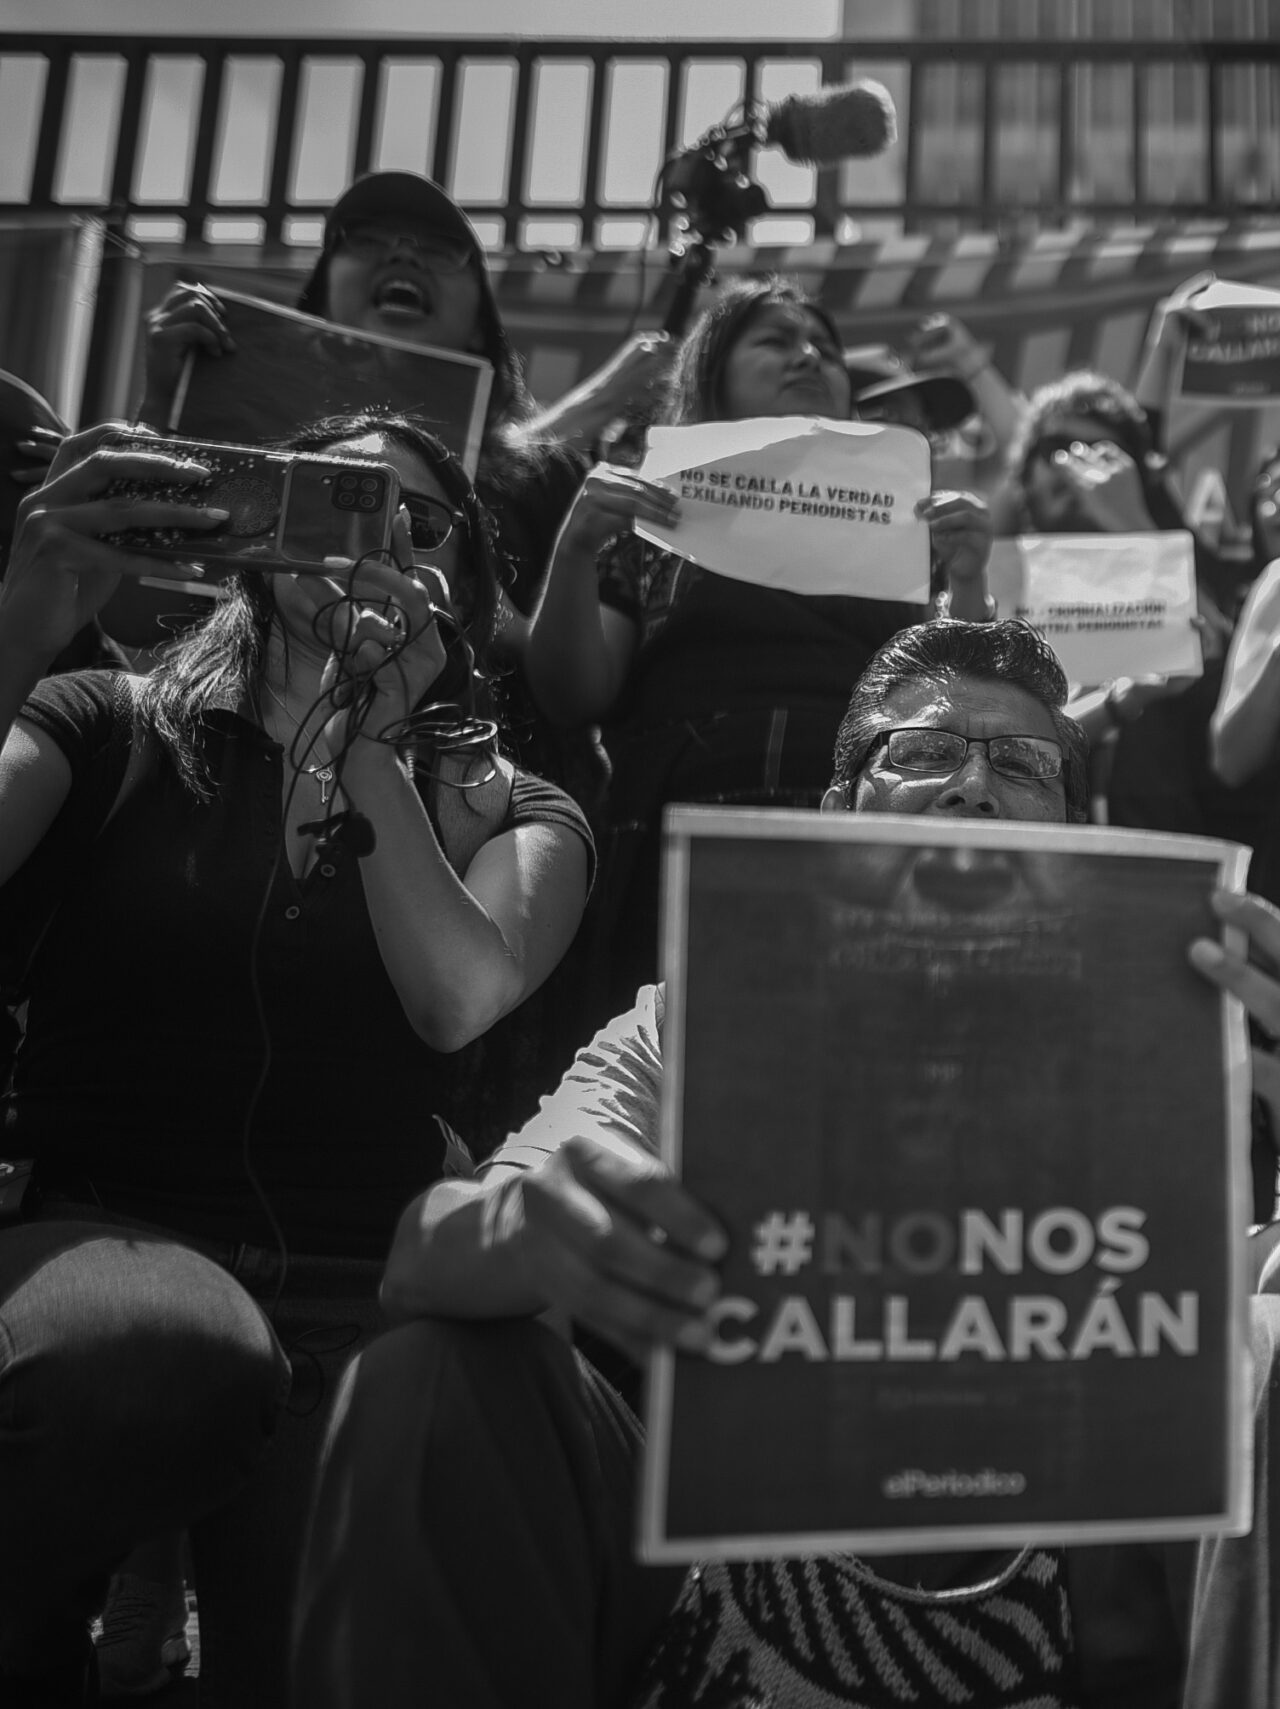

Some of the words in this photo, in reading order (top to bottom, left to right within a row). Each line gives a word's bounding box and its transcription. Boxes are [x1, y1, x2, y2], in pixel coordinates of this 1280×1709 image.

[680, 469, 704, 484] NO
[708, 472, 730, 488] SE
[735, 473, 793, 496] CALLA
[799, 482, 821, 499] LA
[827, 486, 895, 508] VERDAD
[681, 485, 775, 511] EXILIANDO
[779, 499, 892, 525] PERIODISTAS
[751, 1207, 1150, 1276] #NONOS
[706, 1277, 1200, 1364] CALLARÁN
[882, 1468, 1027, 1499] elPeriodico
